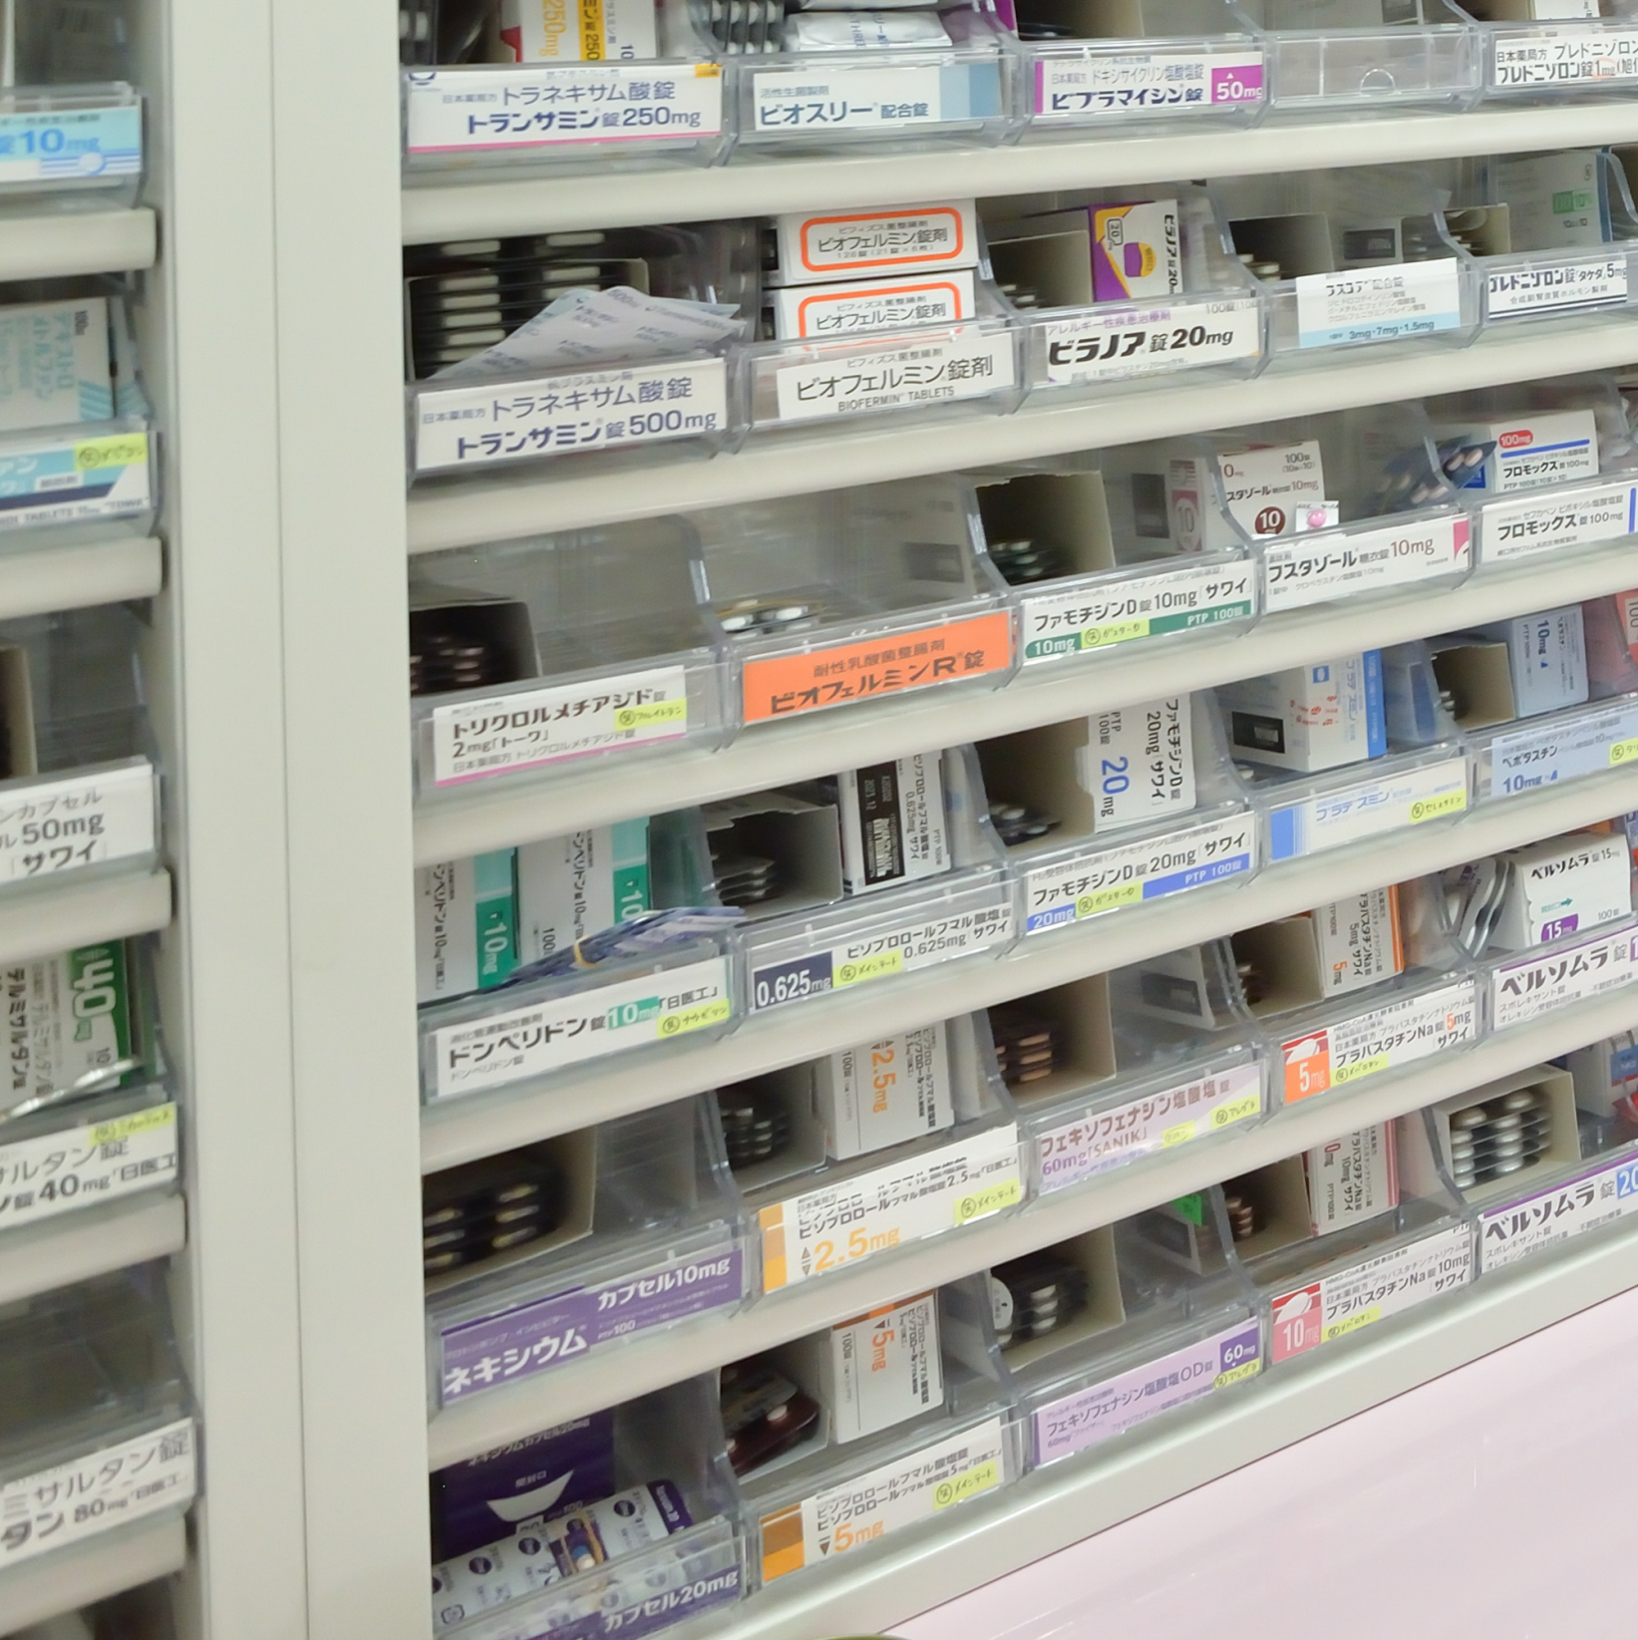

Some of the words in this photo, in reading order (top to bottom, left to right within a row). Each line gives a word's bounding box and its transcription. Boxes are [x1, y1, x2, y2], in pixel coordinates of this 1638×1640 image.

[907, 386, 955, 402] TABLETS
[1260, 509, 1280, 529] 10
[1186, 614, 1210, 626] PTP
[1212, 606, 1244, 621] 100錠
[1034, 638, 1076, 657] 10mg
[1503, 773, 1543, 793] 10mg
[1034, 907, 1075, 929] 20mg
[756, 967, 832, 1009] 0.625mg
[1299, 1060, 1326, 1091] 5mg
[813, 1225, 901, 1273] 2.5mg
[1281, 1317, 1321, 1351] 10mg
[1223, 1343, 1256, 1364] 60mg
[833, 1519, 884, 1553] 5mg
